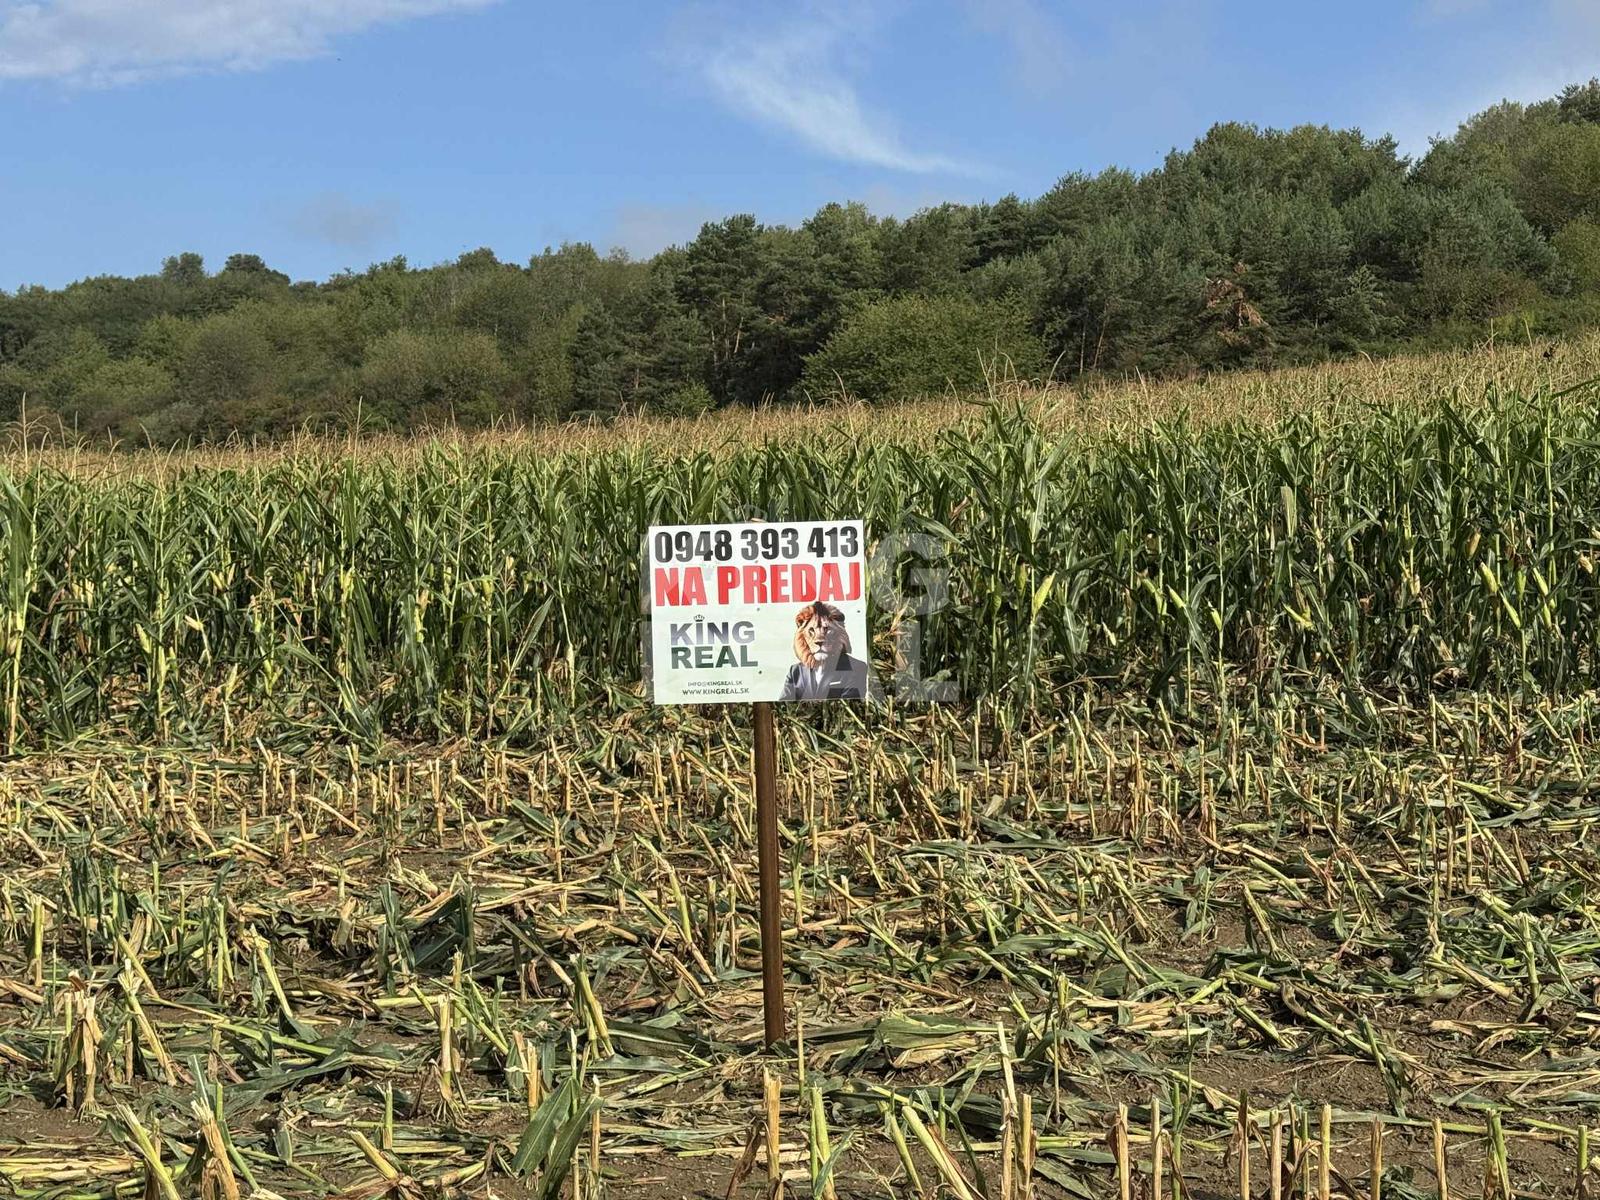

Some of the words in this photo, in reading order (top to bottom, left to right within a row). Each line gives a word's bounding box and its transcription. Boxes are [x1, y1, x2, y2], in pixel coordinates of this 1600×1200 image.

[654, 530, 733, 563] 0948
[740, 528, 799, 560] 393
[807, 526, 859, 558] 413
[655, 566, 708, 606] NA
[717, 561, 861, 605] PREDAJ
[670, 620, 756, 646] KING
[671, 645, 759, 669] REAL
[682, 687, 750, 696] WWW.KINGREAL.SK
